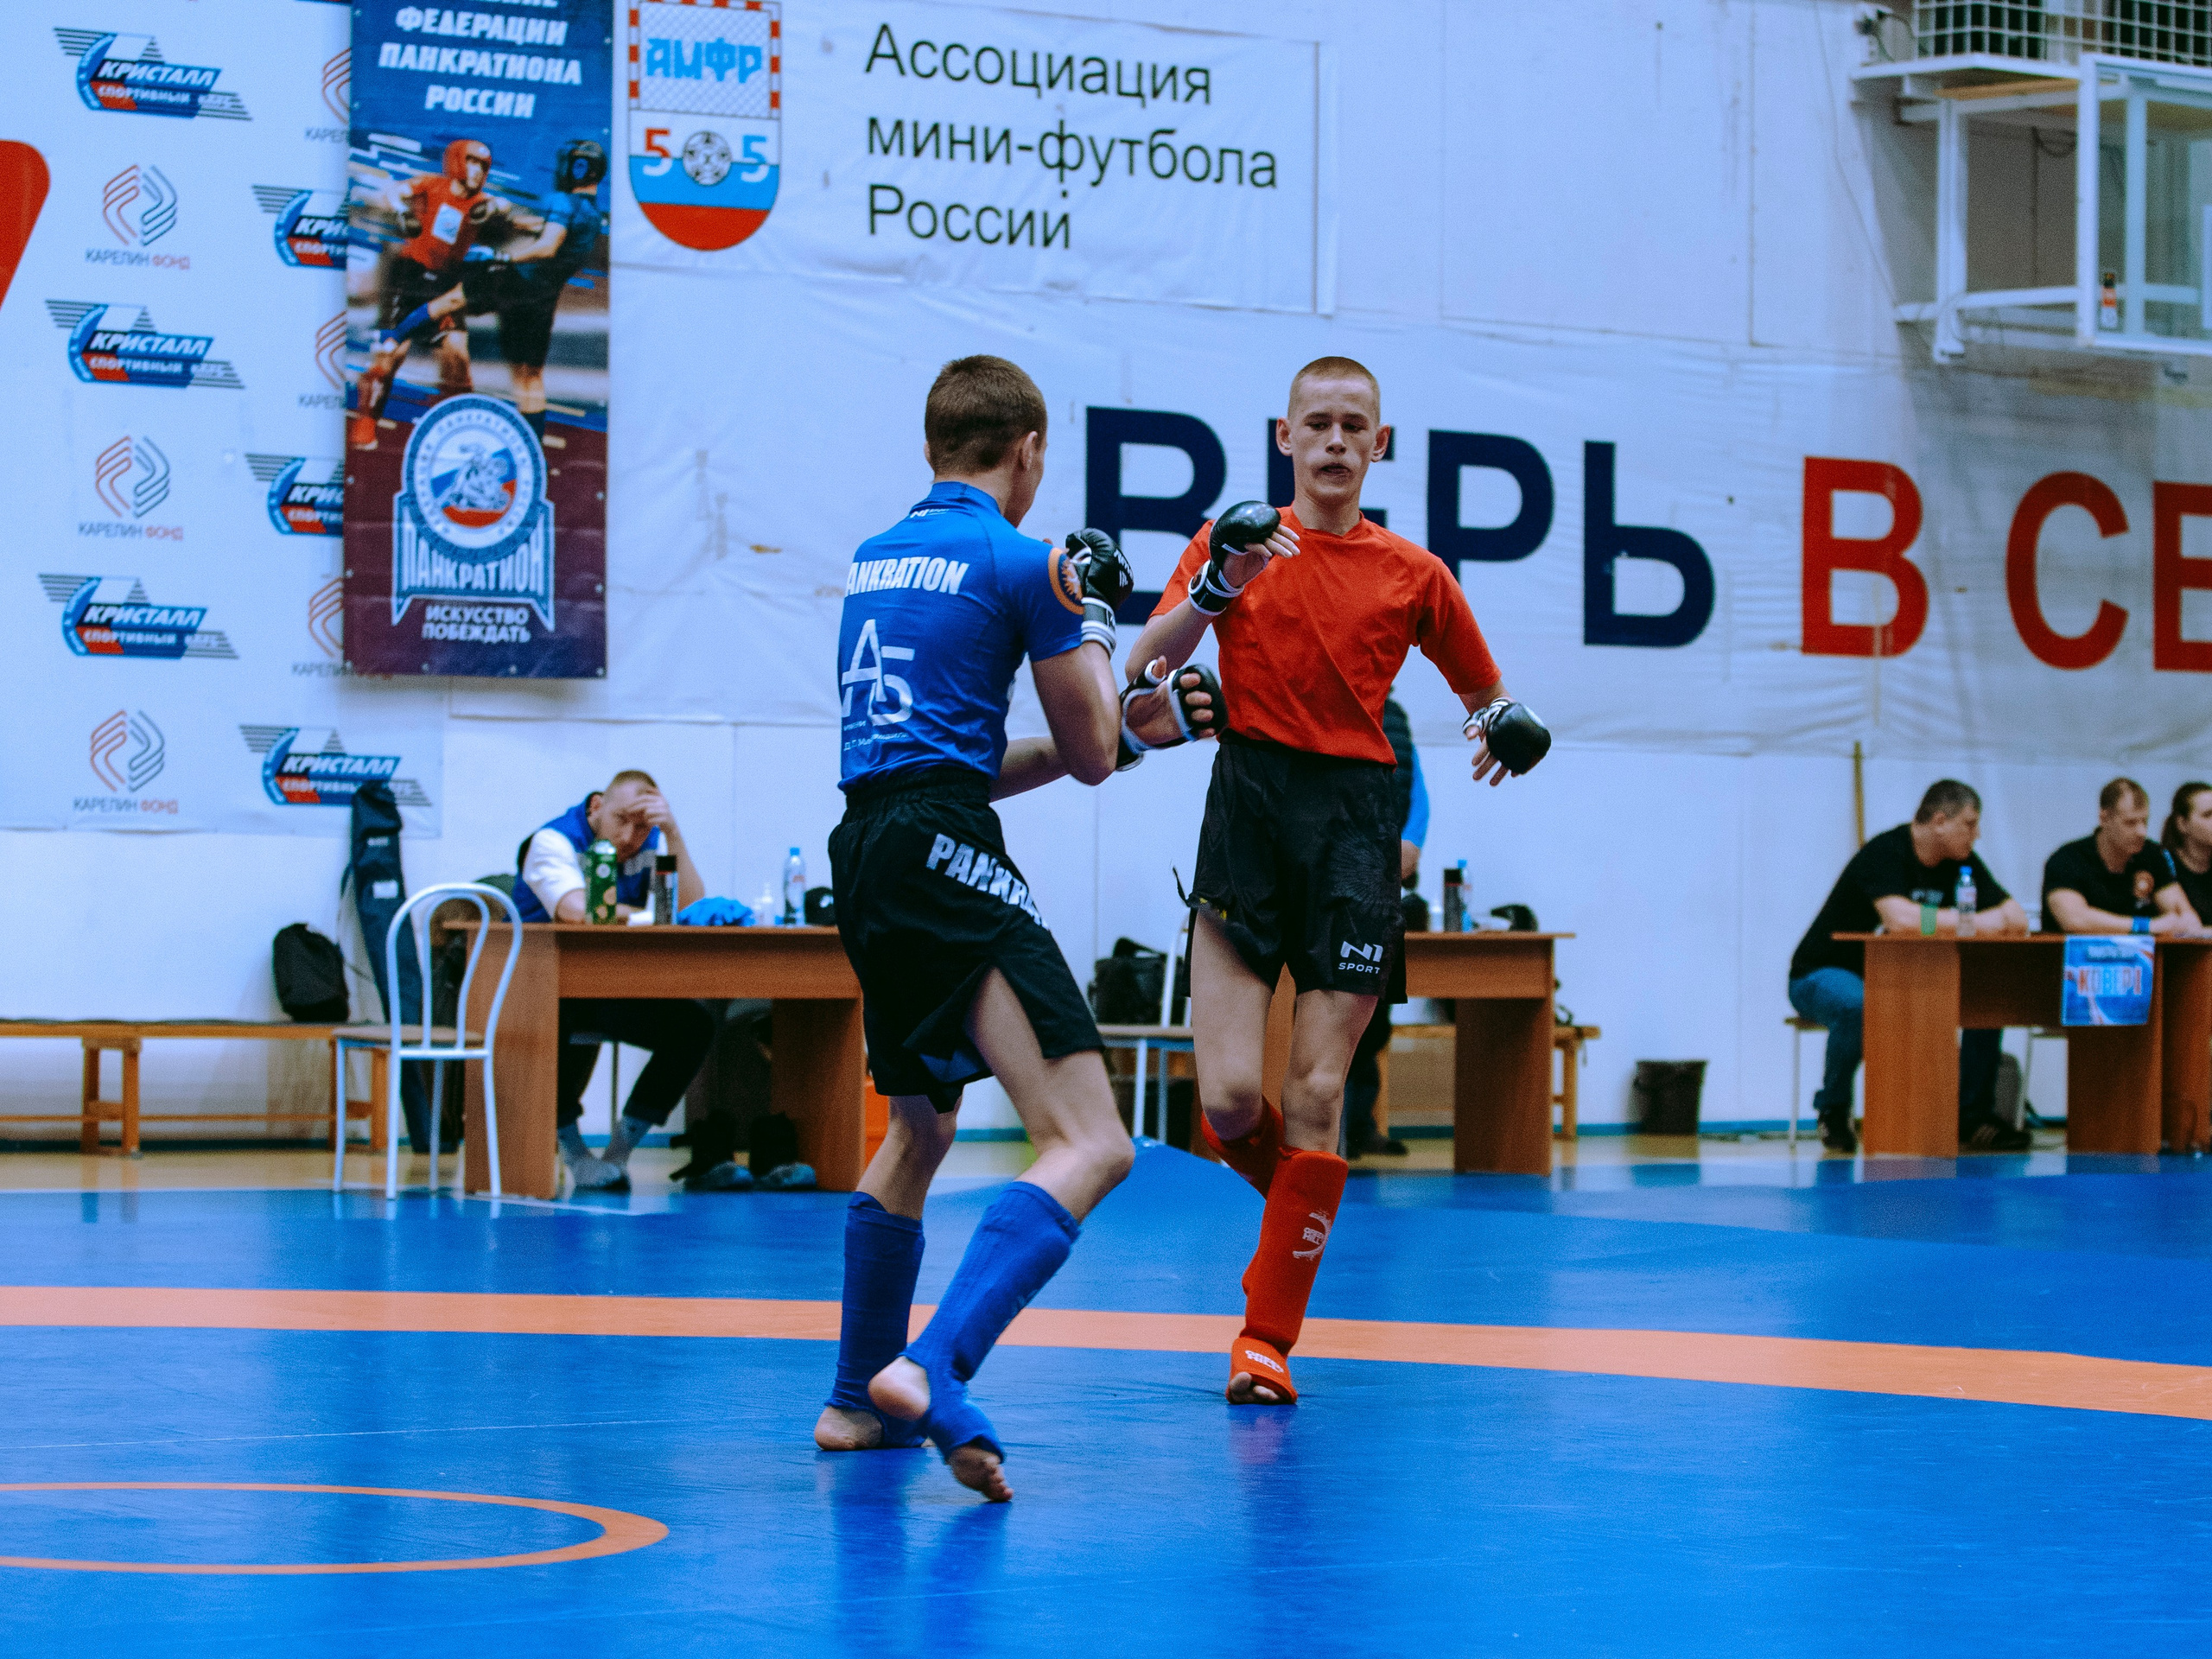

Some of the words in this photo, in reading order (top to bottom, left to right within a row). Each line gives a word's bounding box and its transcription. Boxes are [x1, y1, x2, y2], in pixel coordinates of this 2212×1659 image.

[395, 6, 569, 46] ФЕДЕРАЦИИ
[98, 60, 216, 87] КРИСТАЛЛ
[378, 41, 583, 86] ПАНКРАТИОНА
[865, 22, 1212, 110] Ассоциация
[424, 84, 537, 119] РОССИИ
[867, 116, 1278, 188] мини-футбола
[869, 183, 1071, 250] России
[86, 248, 150, 268] КАРЕЛИН
[90, 332, 207, 356] КРИСТАЛЛ
[79, 522, 143, 539] КАРЕЛИН
[401, 504, 547, 596] ПАНКРАТИОН
[1802, 455, 1929, 658] В
[845, 556, 969, 595] ANKRATION
[84, 605, 201, 626] КРИСТАЛЛ
[425, 603, 531, 626] ИСКУССТВО
[422, 621, 532, 644] ПОБЕЖДАТЬ
[282, 754, 395, 775] КРИСТАЛЛ
[73, 798, 138, 814] КАРЕЛИН
[1340, 941, 1383, 963] N1
[1338, 962, 1380, 975] SPORT
